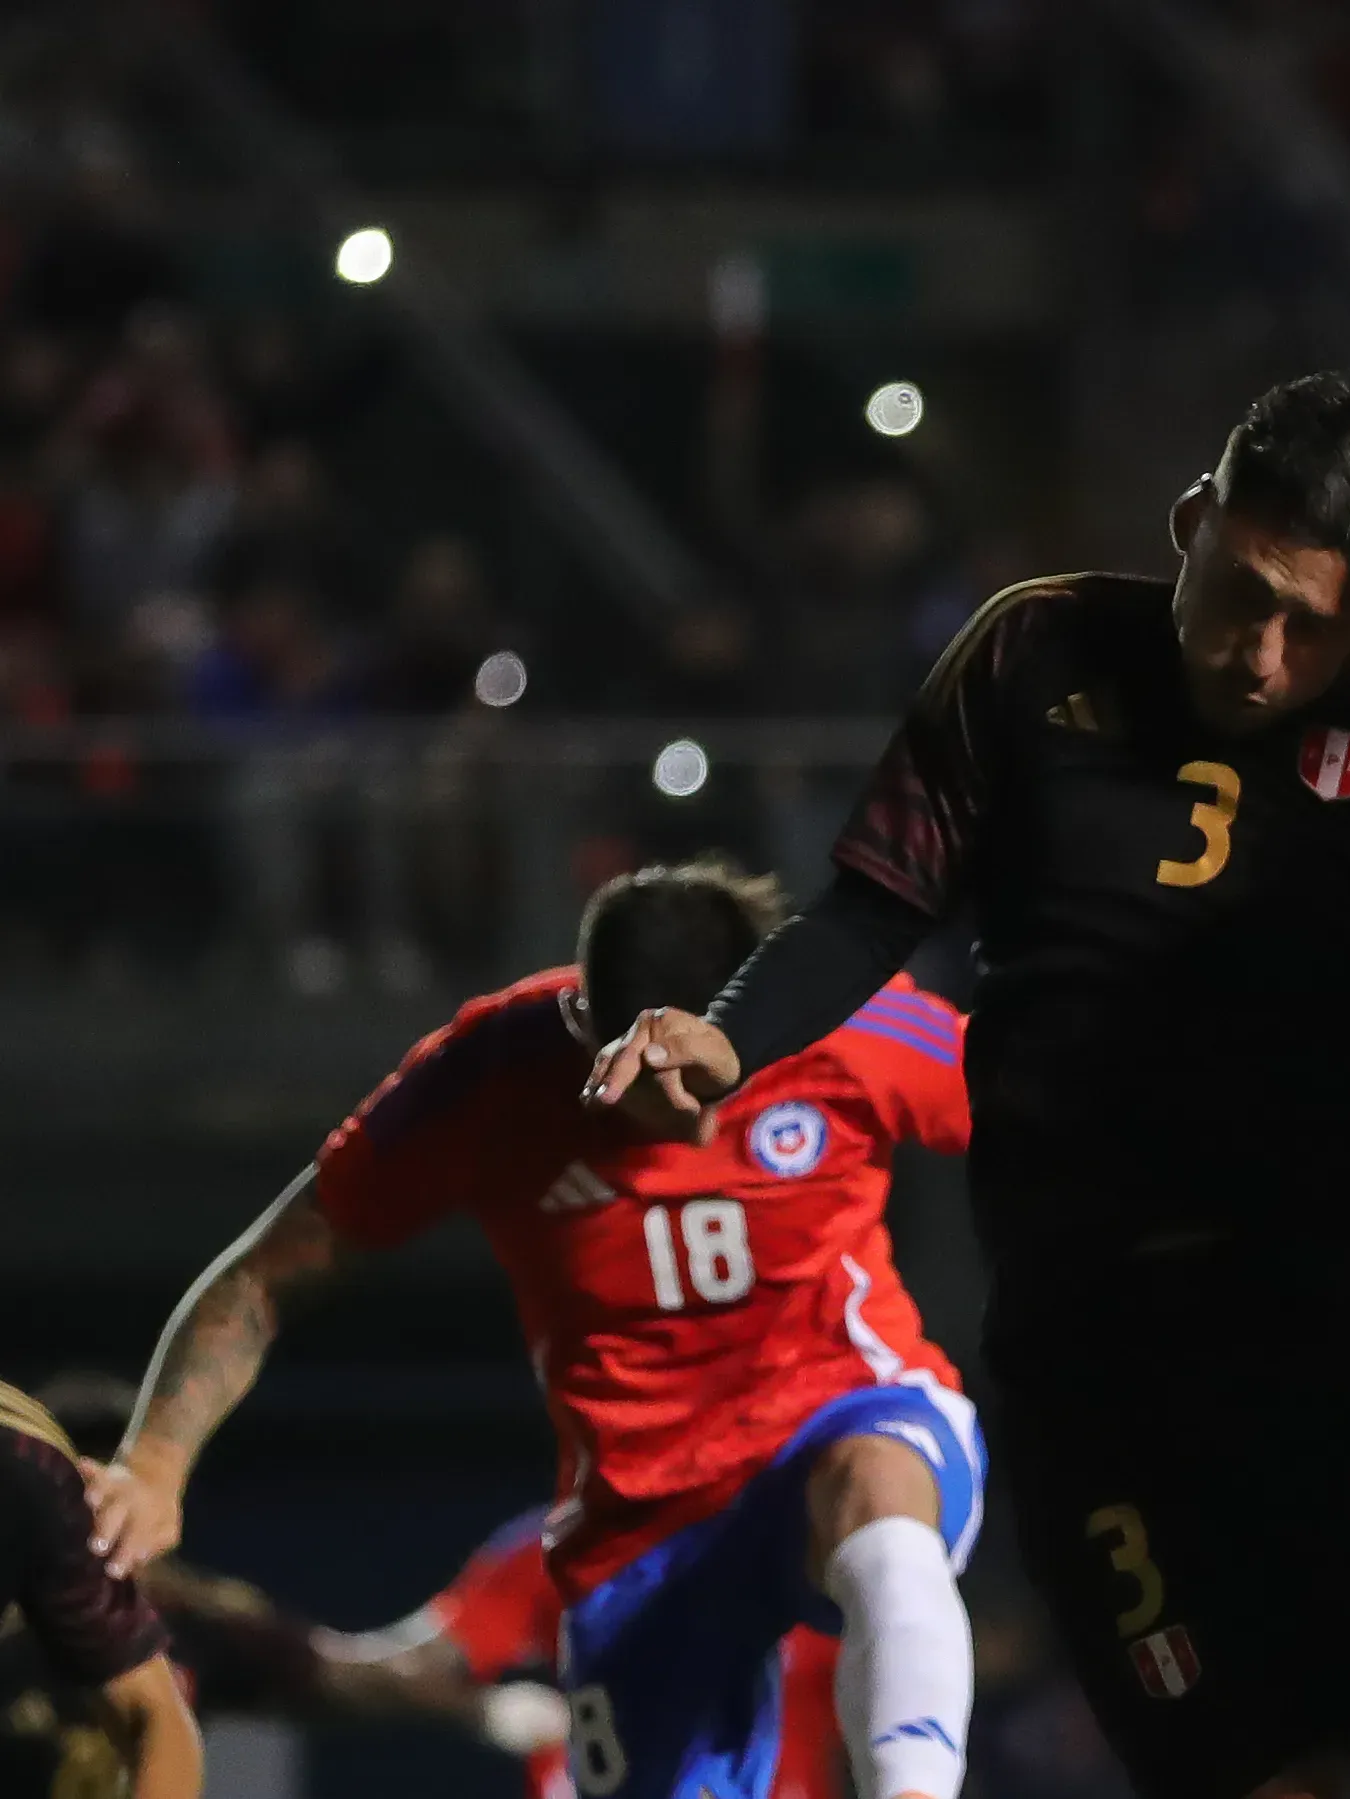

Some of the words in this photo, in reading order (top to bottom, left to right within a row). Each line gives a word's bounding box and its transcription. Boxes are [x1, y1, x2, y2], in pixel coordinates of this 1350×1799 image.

[1156, 760, 1240, 887] 3
[643, 1199, 756, 1311] 18
[1085, 1504, 1164, 1638] 3
